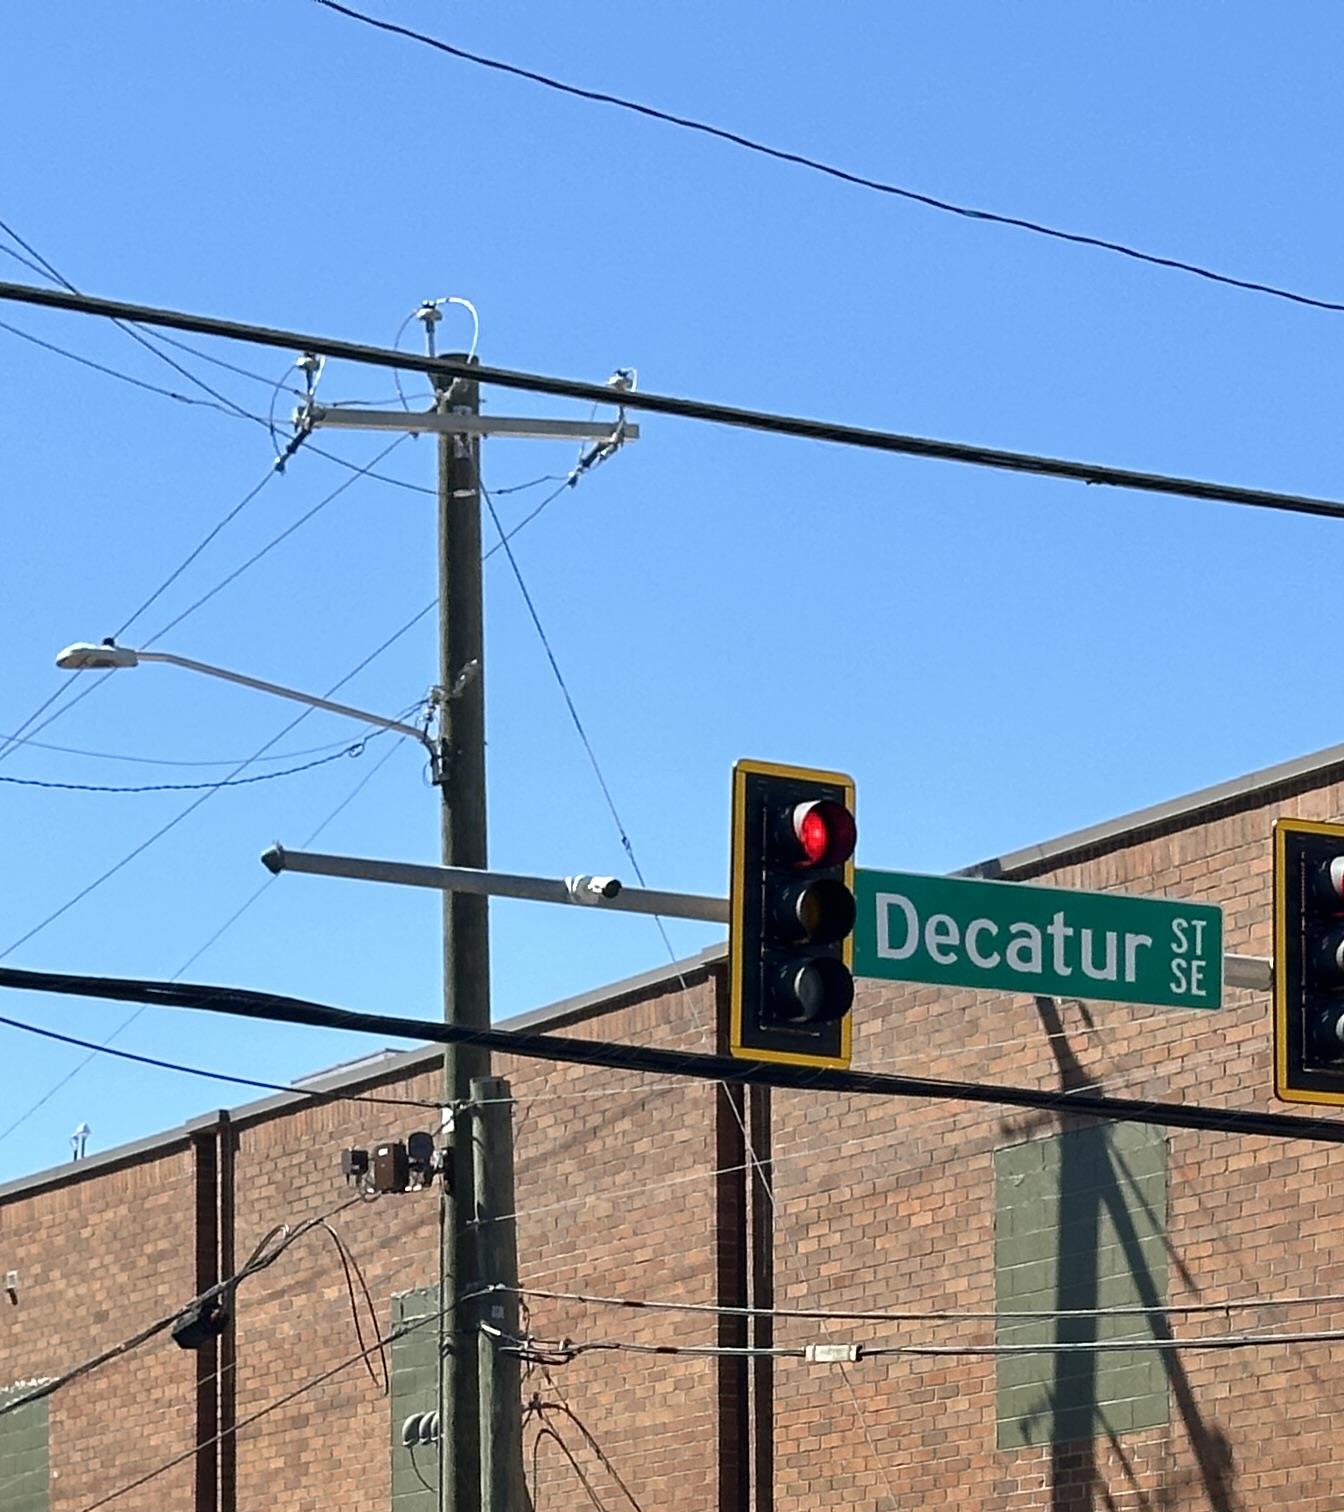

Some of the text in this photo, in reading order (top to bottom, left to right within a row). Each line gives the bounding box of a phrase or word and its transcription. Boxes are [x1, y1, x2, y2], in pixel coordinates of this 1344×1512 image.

[875, 892, 1152, 983] Decatur
[1170, 918, 1207, 957] ST
[1169, 959, 1207, 997] SE
